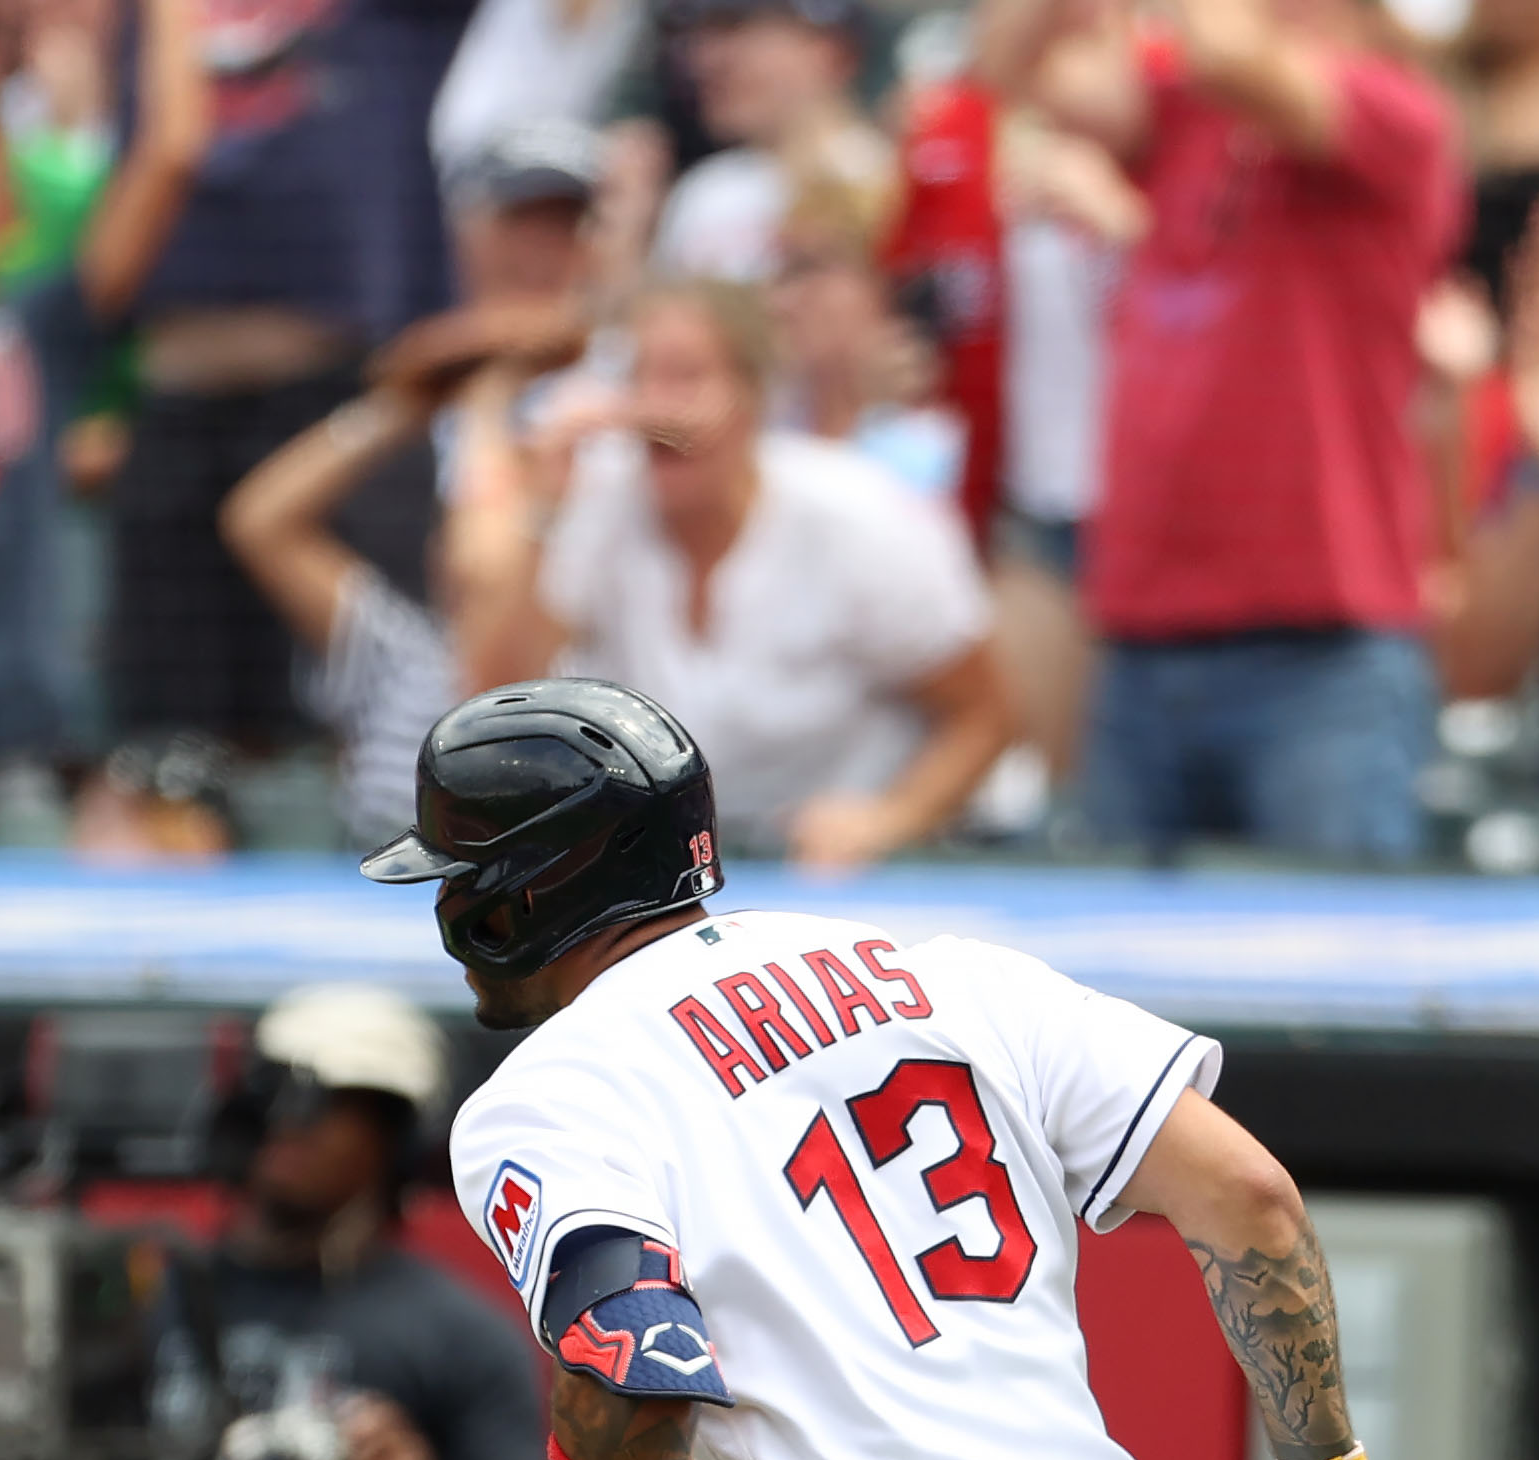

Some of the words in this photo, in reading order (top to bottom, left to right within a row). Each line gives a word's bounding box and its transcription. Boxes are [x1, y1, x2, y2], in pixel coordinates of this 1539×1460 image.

[688, 830, 713, 867] 13
[668, 938, 934, 1100] ARIAS
[490, 1176, 533, 1262] M
[781, 1057, 1039, 1351] 13
